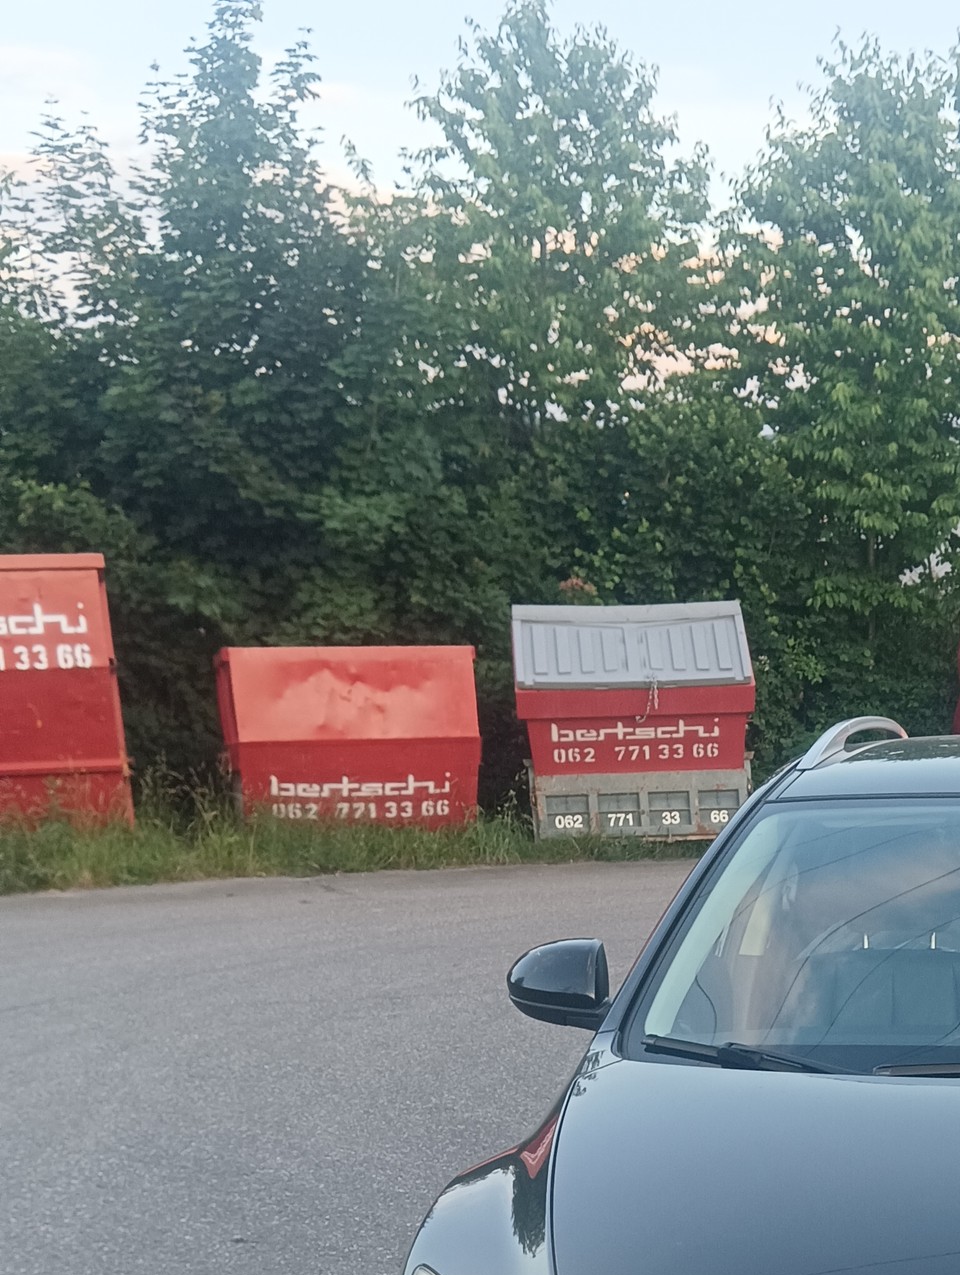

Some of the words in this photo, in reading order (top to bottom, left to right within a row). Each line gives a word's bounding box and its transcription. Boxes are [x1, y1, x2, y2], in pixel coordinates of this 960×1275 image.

[13, 645, 48, 671] 33
[57, 643, 92, 669] 66
[551, 717, 720, 743] bertschi
[553, 747, 596, 764] 062
[614, 745, 650, 761] 771
[658, 744, 684, 760] 33
[692, 743, 719, 758] 66
[269, 771, 451, 798] bertschi
[272, 802, 319, 820] 062
[336, 801, 377, 819] 771
[385, 801, 413, 818] 33
[421, 799, 450, 817] 66
[555, 815, 584, 829] 062
[608, 813, 634, 827] 771
[662, 811, 681, 825] 33
[710, 809, 729, 824] 66
